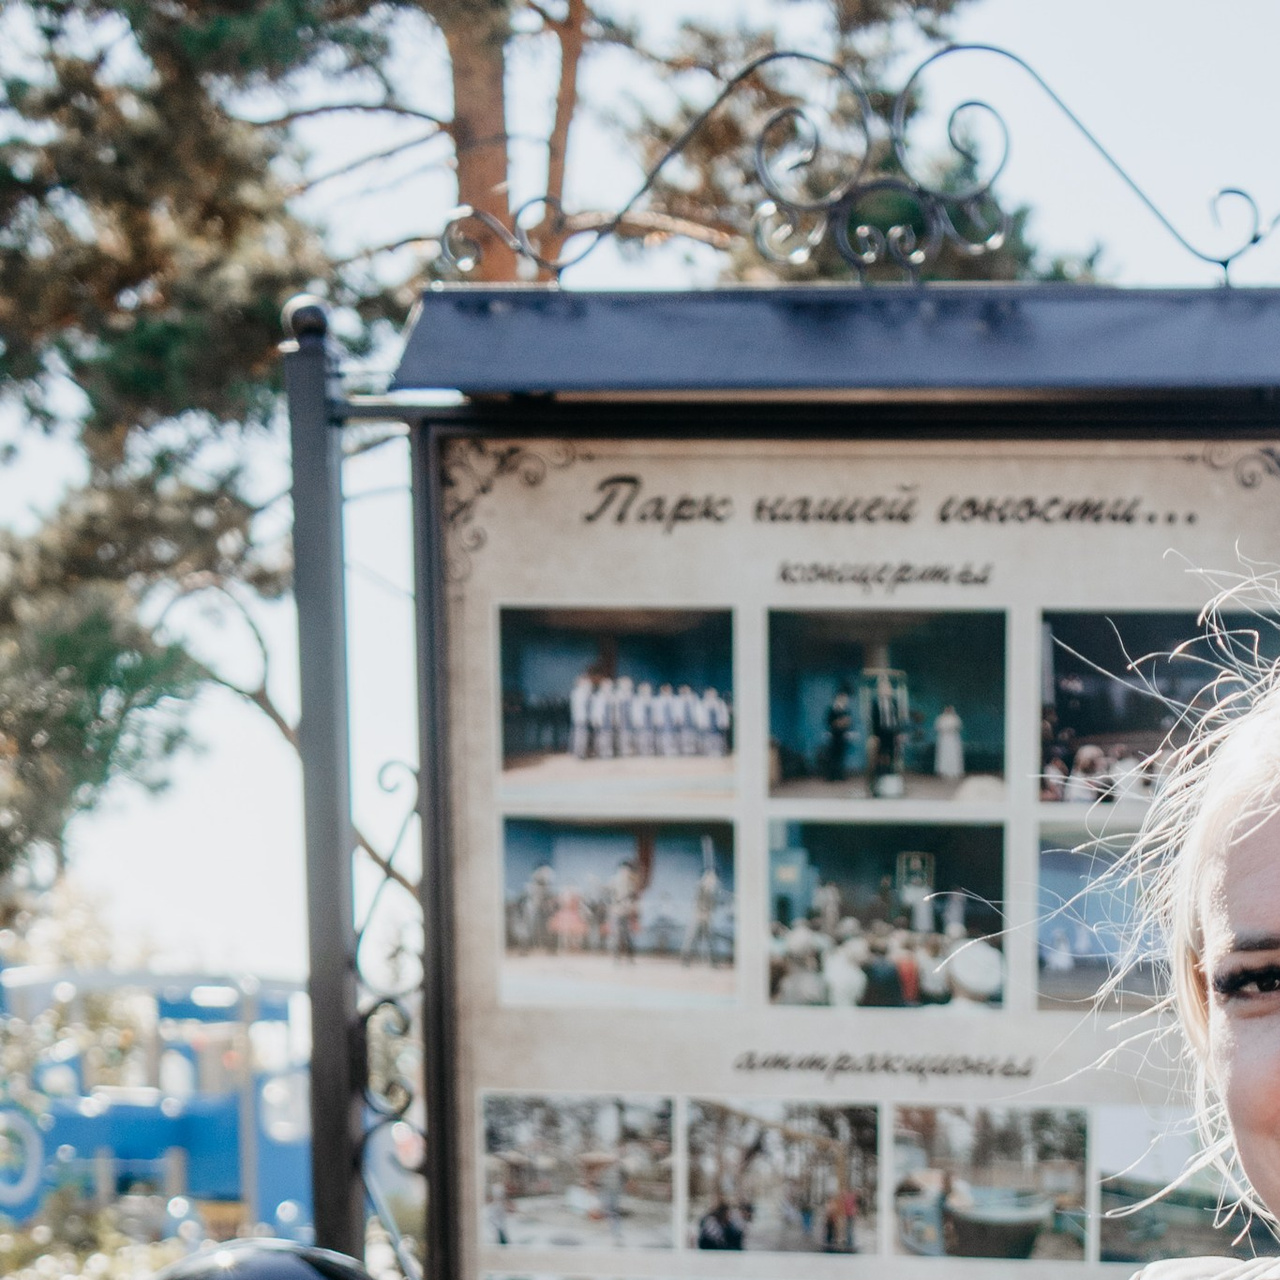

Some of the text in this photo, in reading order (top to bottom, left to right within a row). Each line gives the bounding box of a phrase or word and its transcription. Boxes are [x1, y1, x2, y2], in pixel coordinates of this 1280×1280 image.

[581, 474, 1197, 534] Парк нашей юности...
[777, 560, 993, 593] концерты
[733, 1051, 1035, 1086] аттракционы
